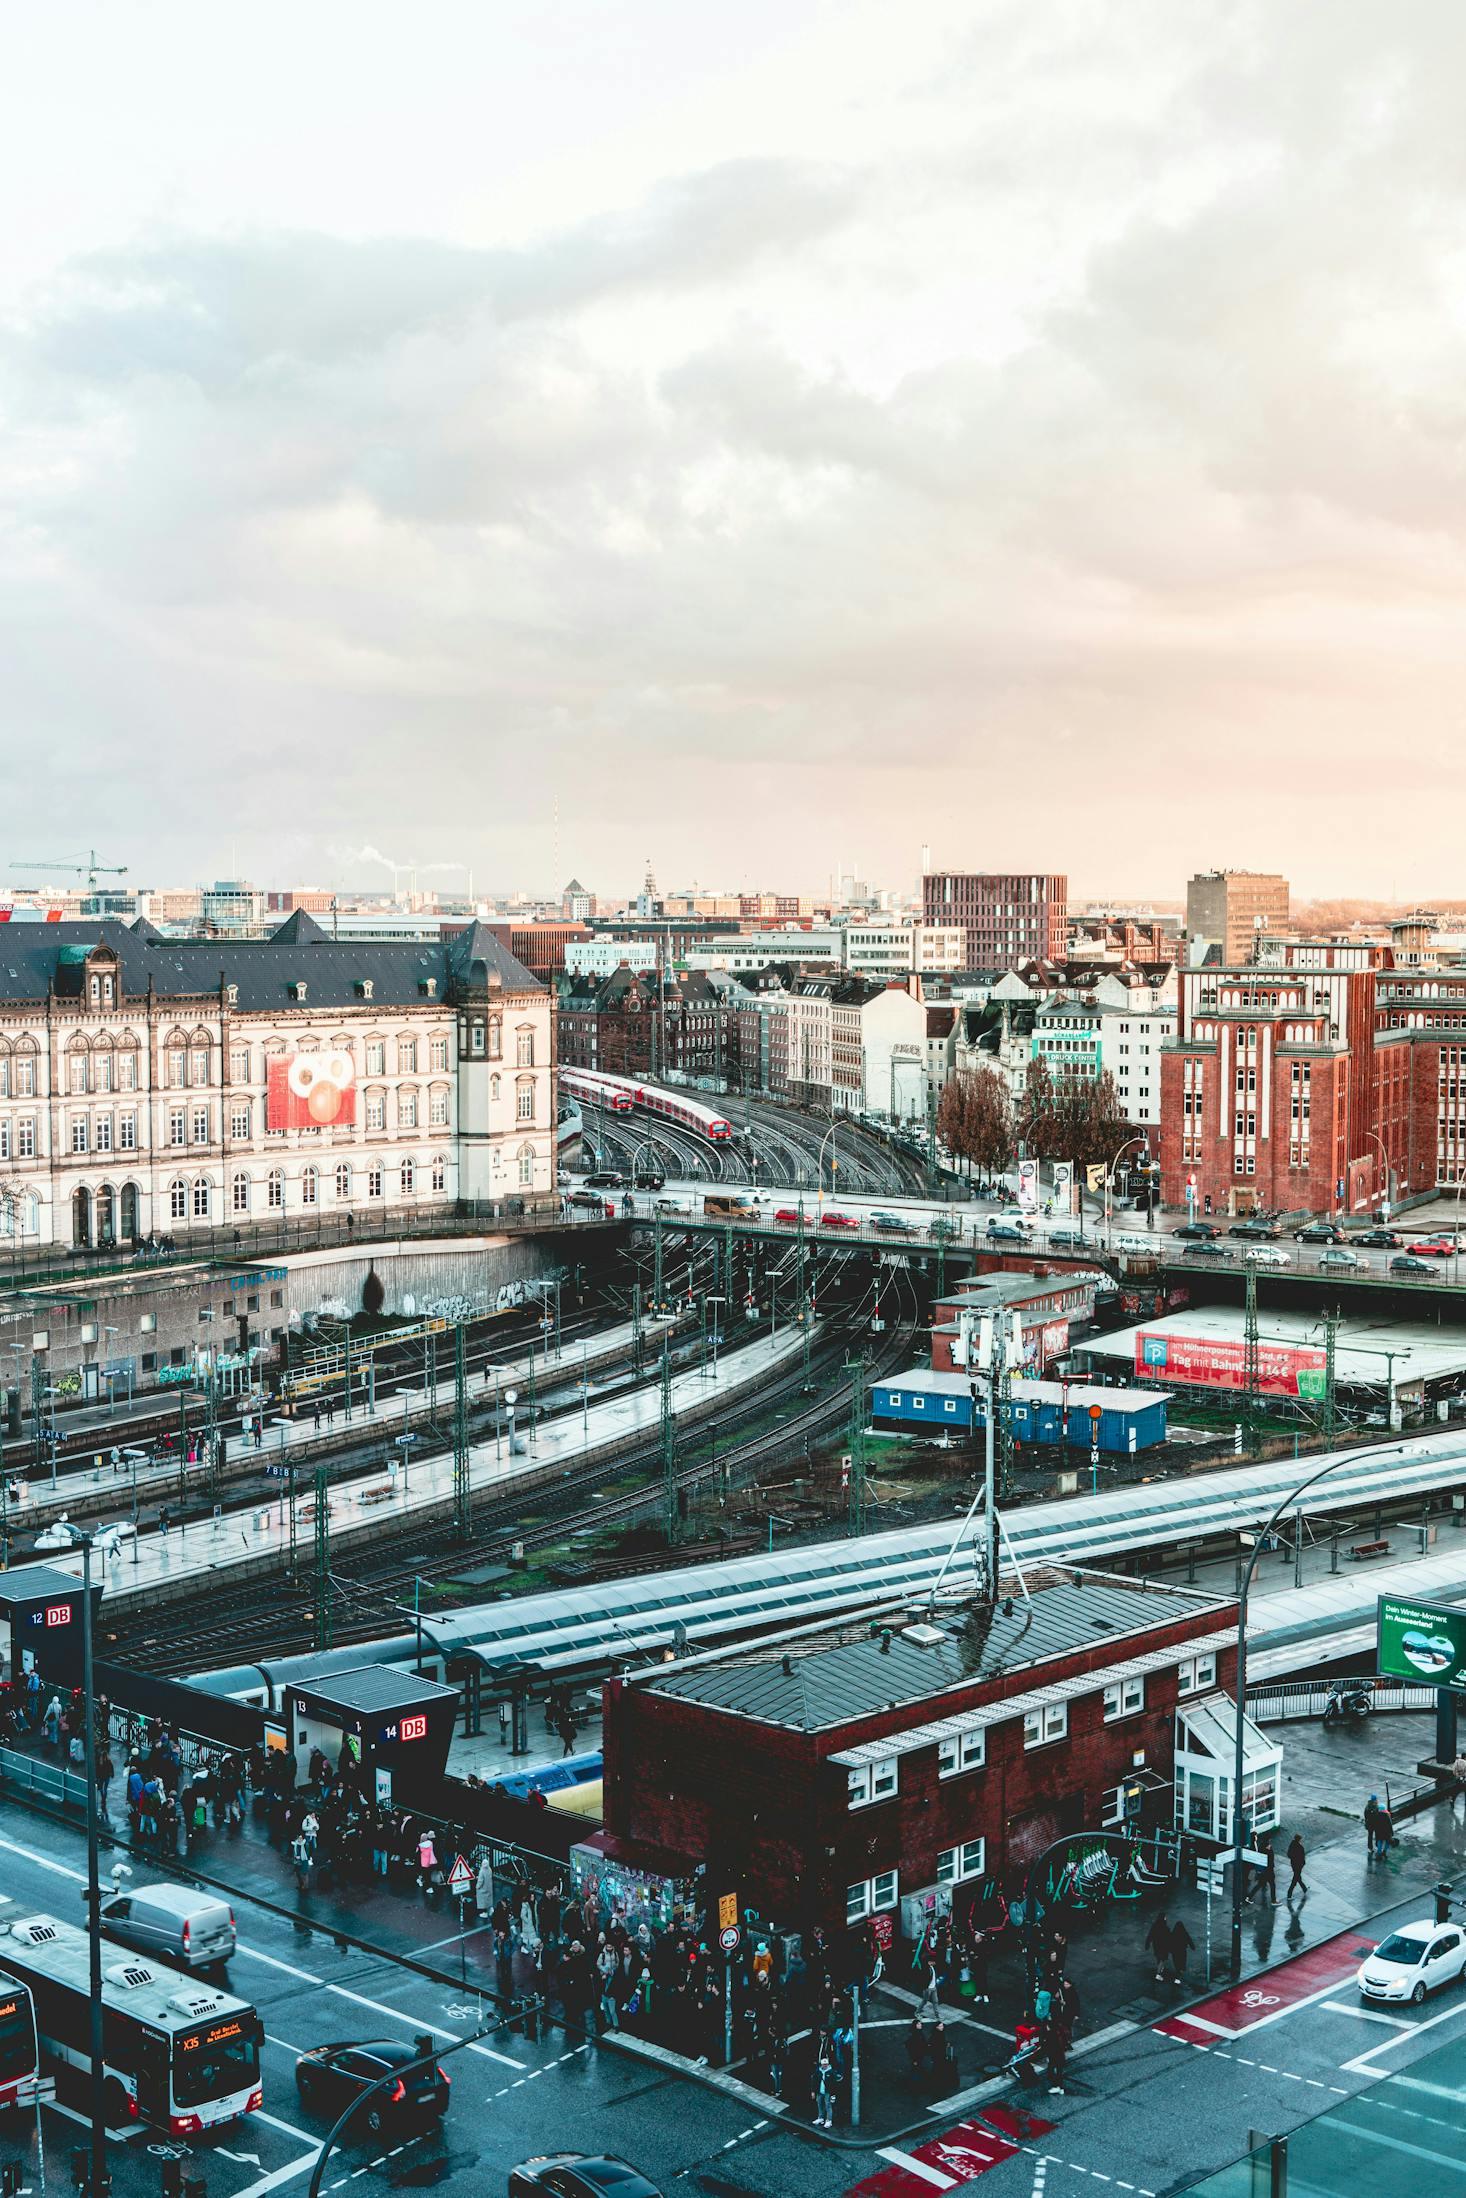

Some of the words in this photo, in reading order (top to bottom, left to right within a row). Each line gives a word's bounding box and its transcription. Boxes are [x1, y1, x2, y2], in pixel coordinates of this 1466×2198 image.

[1172, 1353, 1191, 1368] Tag
[1193, 1357, 1209, 1367] mit
[32, 1612, 43, 1624] 12
[48, 1607, 70, 1626] DB
[1385, 1605, 1400, 1614] Dein
[1400, 1608, 1448, 1623] Winter-Moment
[297, 1700, 306, 1713] 13
[385, 1725, 397, 1738] 14
[402, 1718, 425, 1739] DB
[183, 2036, 199, 2051] X35
